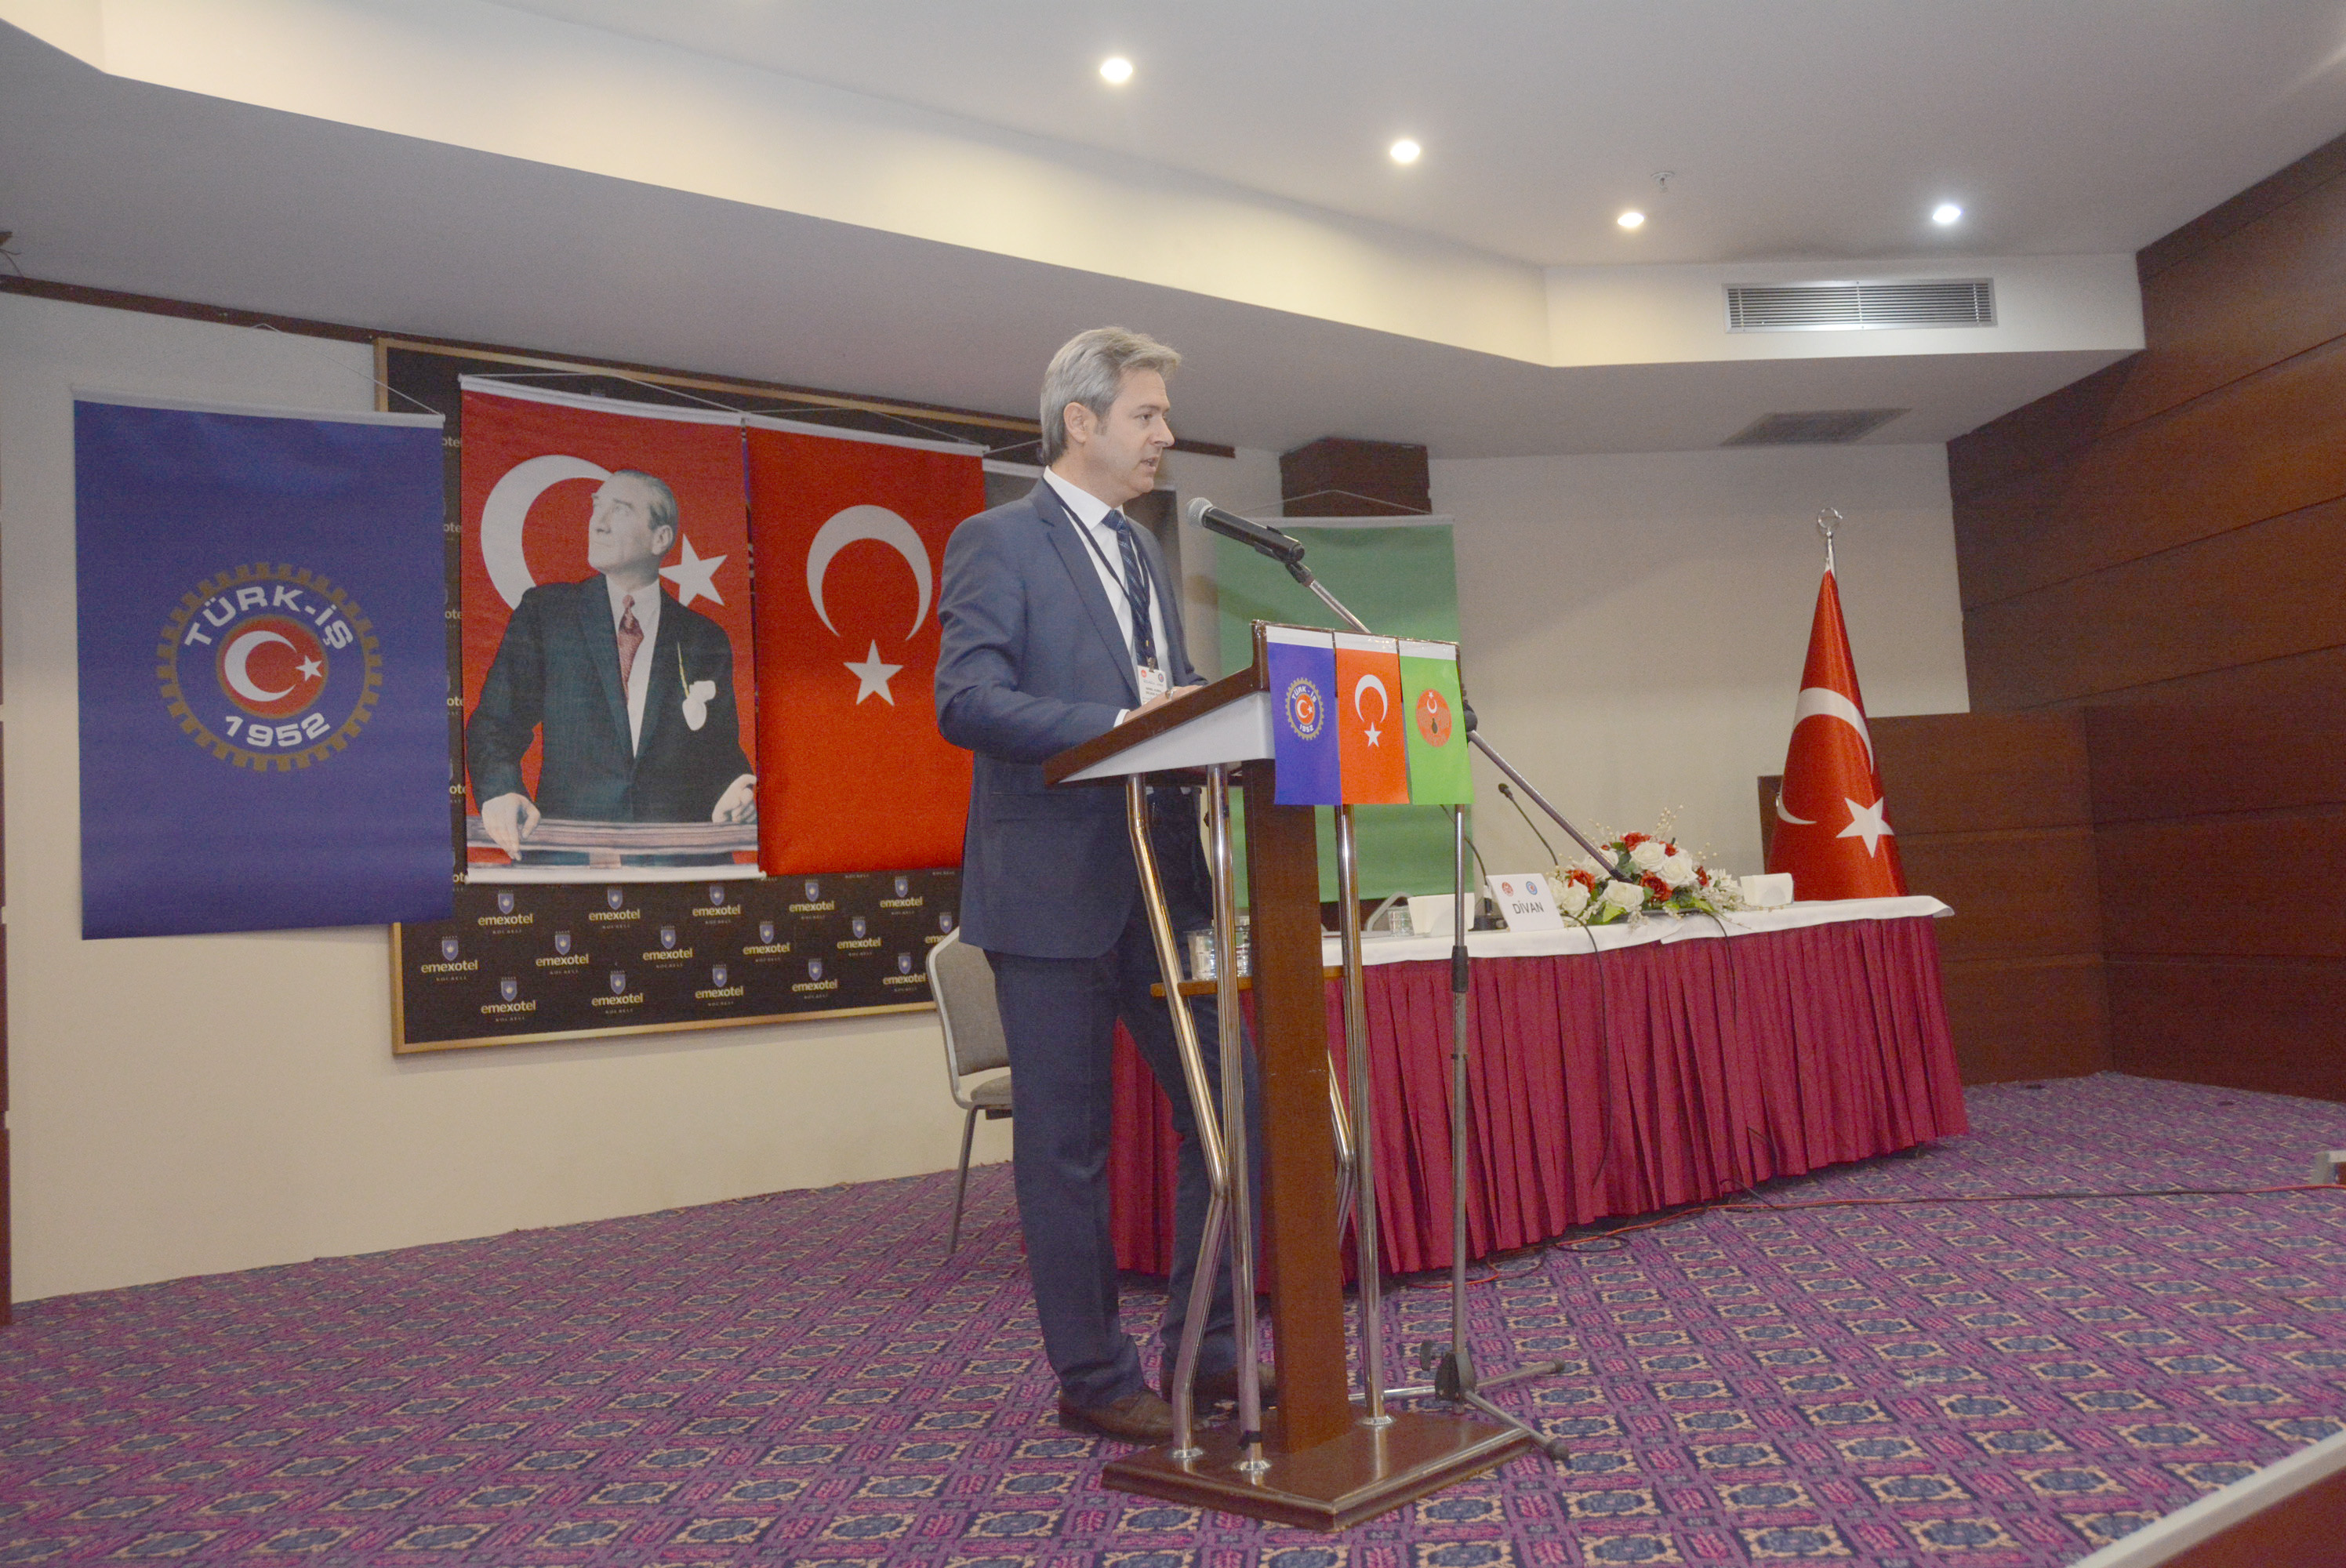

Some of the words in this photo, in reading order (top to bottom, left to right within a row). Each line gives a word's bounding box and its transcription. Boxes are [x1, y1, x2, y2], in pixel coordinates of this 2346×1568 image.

[184, 586, 353, 650] TÜRK-İŞ
[226, 713, 330, 746] 1952
[1299, 724, 1314, 733] 1952
[790, 901, 834, 912] emexotel
[880, 896, 923, 907] emexotel
[1513, 900, 1544, 914] DİVAN
[589, 909, 640, 920] emexotel
[692, 904, 740, 916] emexotel
[478, 913, 533, 926] emexotel
[743, 942, 790, 955] emexotel
[837, 937, 881, 949] emexotel
[536, 953, 590, 967] emexotel
[643, 948, 692, 960] emexotel
[421, 960, 478, 973] emexotel
[792, 978, 837, 992] emexotel
[883, 973, 926, 985] emexotel
[695, 986, 743, 999] emexotel
[591, 993, 643, 1006] emexotel
[481, 1000, 536, 1014] emexotel
